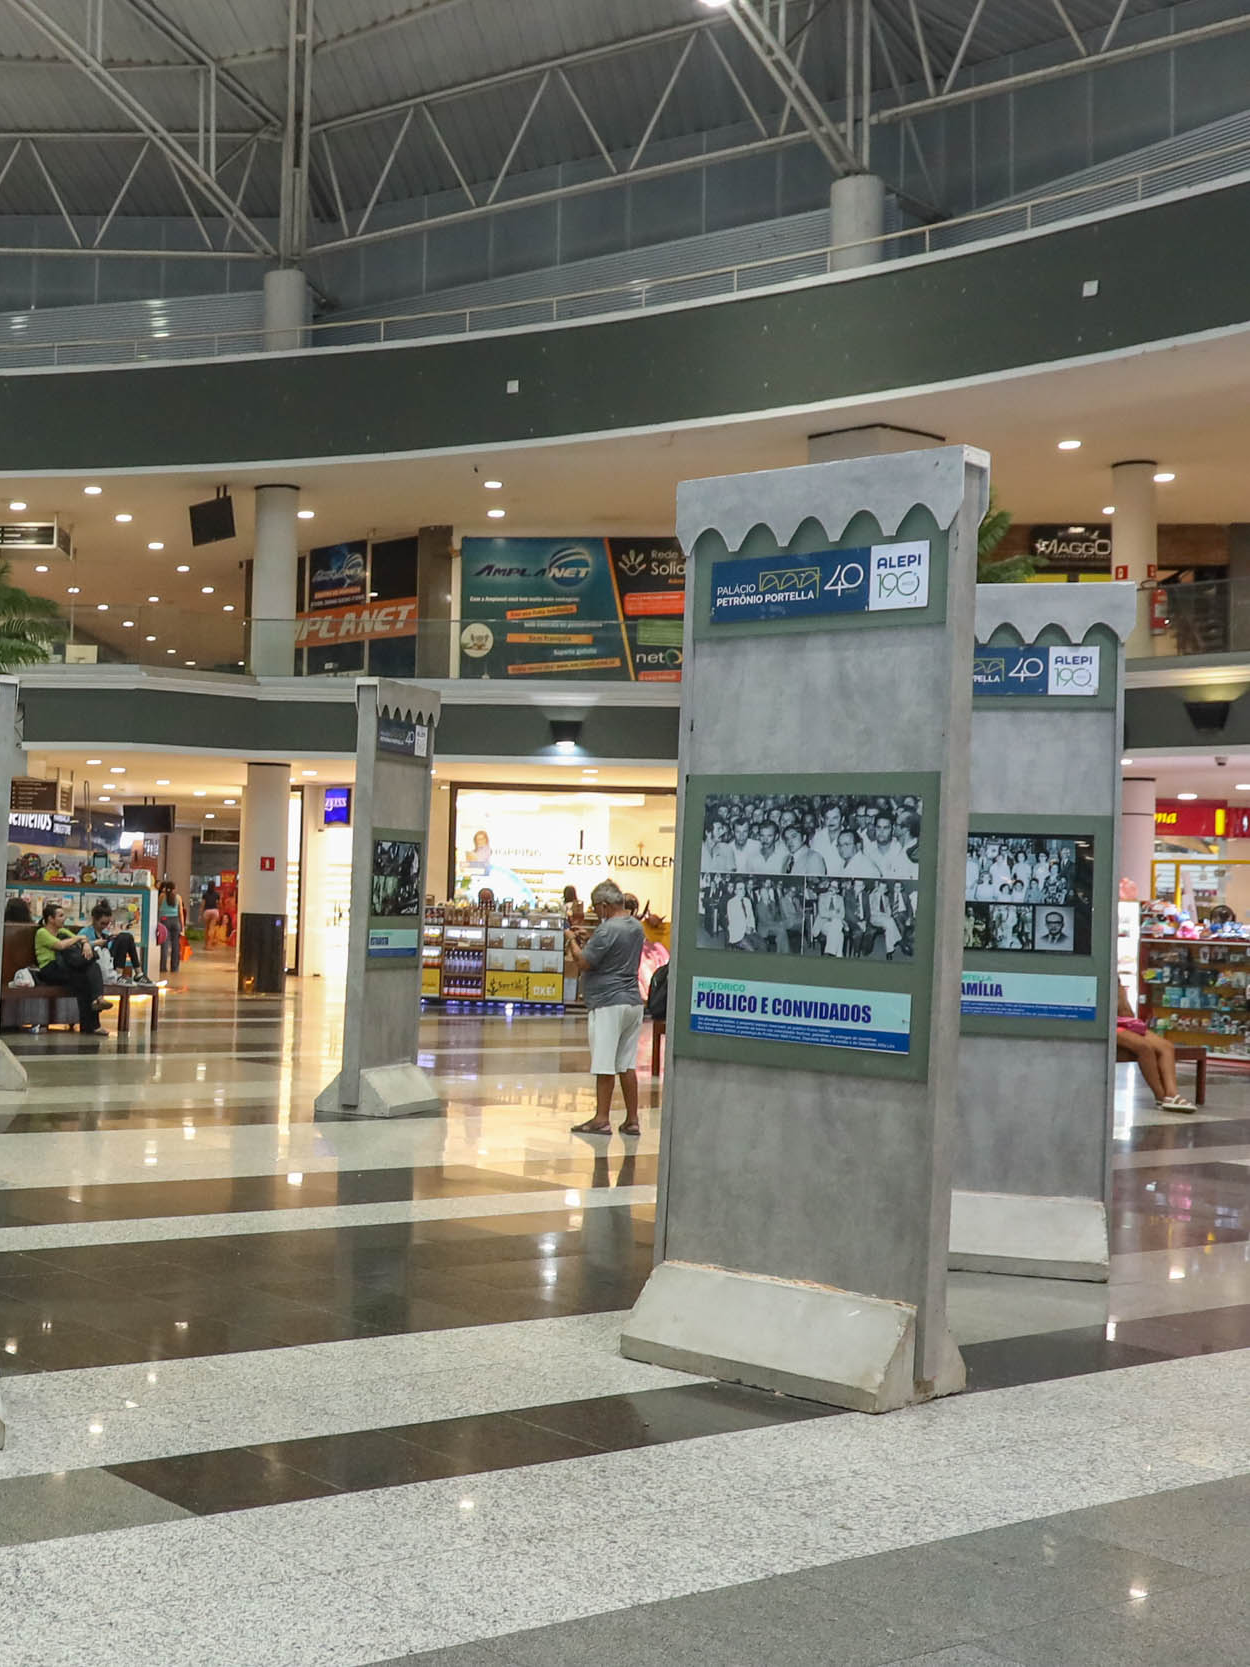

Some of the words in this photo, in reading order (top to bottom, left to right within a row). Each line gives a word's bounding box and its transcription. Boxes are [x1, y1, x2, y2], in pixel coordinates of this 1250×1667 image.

[651, 550, 678, 559] Rede
[877, 554, 921, 569] ALEPI
[824, 563, 864, 597] 40
[877, 571, 920, 599] 190
[717, 582, 756, 595] PALÁCIO
[716, 593, 763, 607] PETRÔNIO
[765, 589, 814, 603] PORTELLA
[1054, 656, 1092, 665] ALEPI
[1008, 658, 1044, 682] 40
[1054, 667, 1092, 687] 190
[974, 675, 1000, 683] TELLA
[1153, 812, 1177, 824] ma
[567, 853, 602, 866] ZEISS
[605, 855, 649, 867] VISION
[652, 856, 674, 868] CEN
[698, 981, 746, 992] HISTÓRICO
[961, 981, 1003, 997] AMÍLIA
[696, 989, 757, 1014] PÚBLICO
[761, 997, 768, 1014] E
[772, 997, 872, 1023] CONVIDADOS
